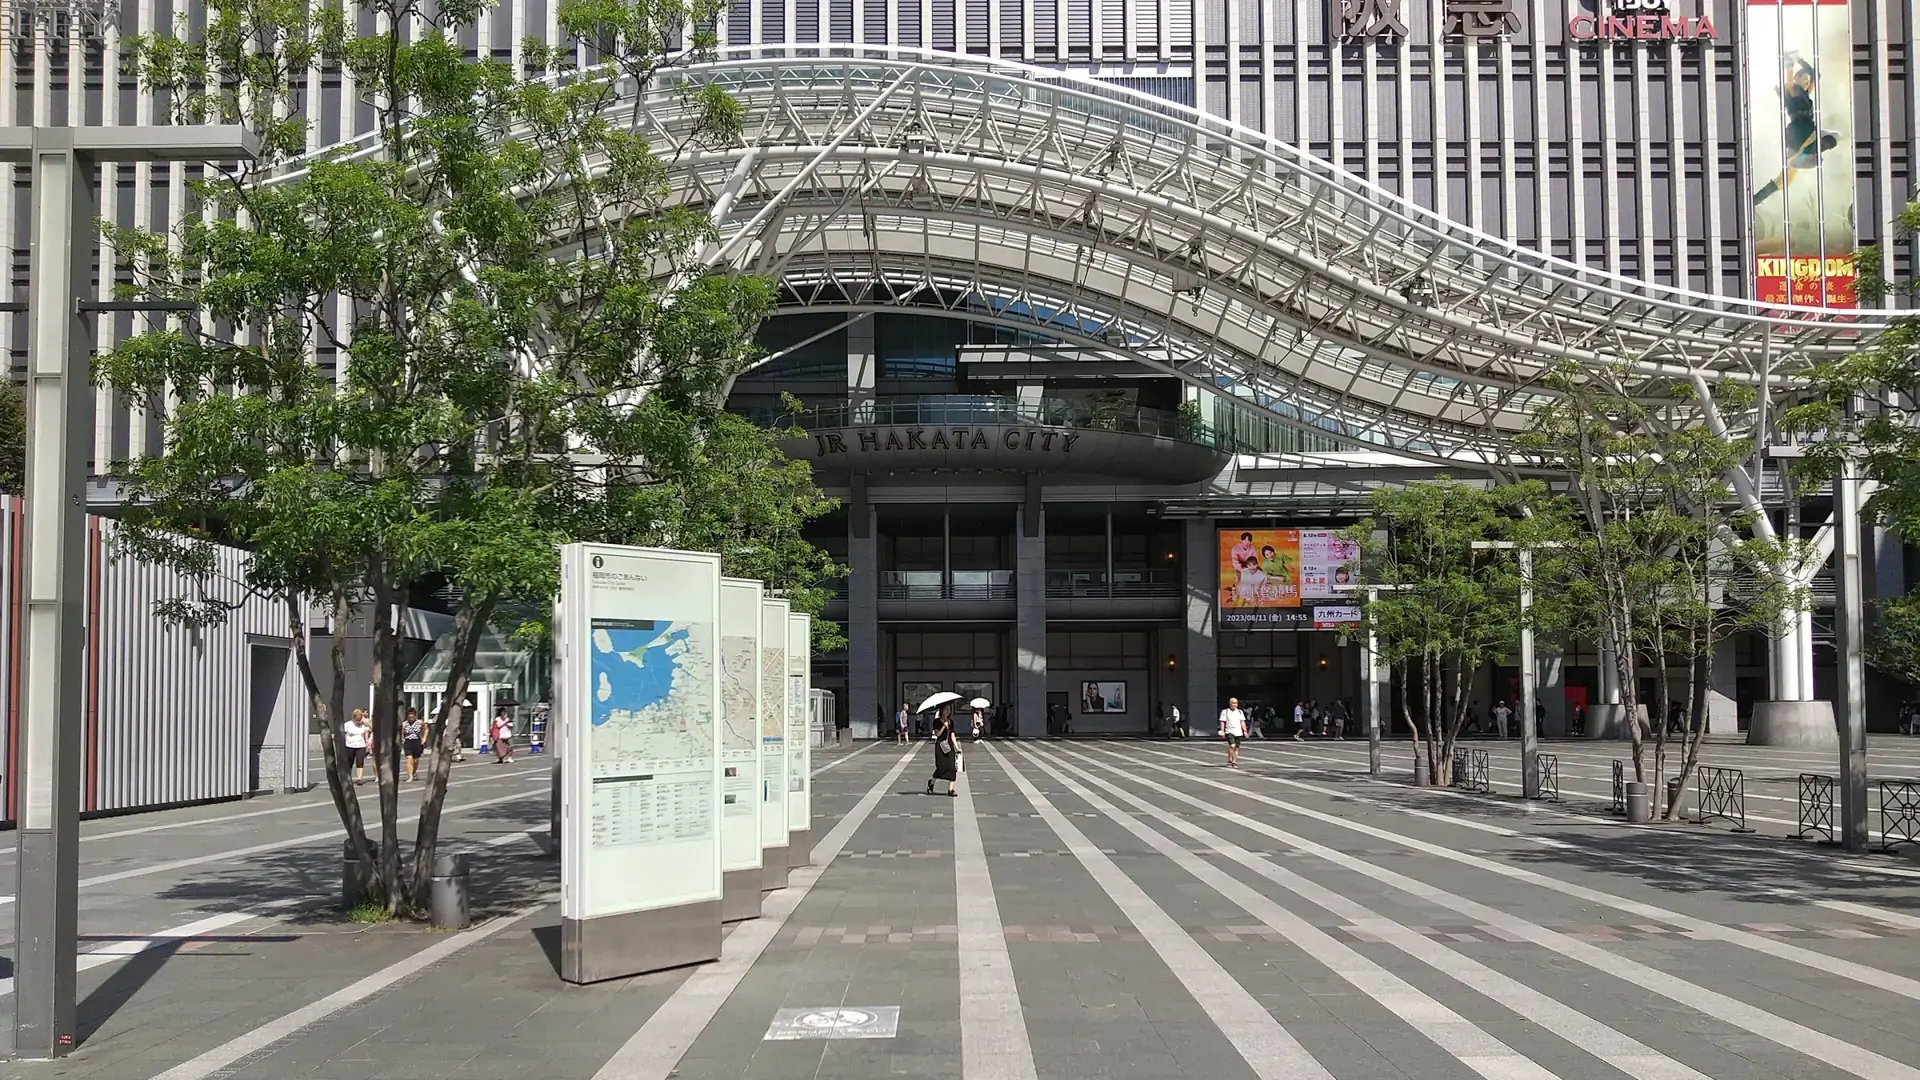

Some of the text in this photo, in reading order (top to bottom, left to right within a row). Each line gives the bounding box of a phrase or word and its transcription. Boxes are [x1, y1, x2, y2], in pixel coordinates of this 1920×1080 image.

[1569, 15, 1719, 39] CINEMA
[1758, 258, 1854, 277] KINGDOM
[814, 428, 1080, 457] JR HAKATA CITY
[1226, 613, 1308, 623] 2023/08/11 (金) 14:55
[1318, 609, 1358, 618] 九州カード
